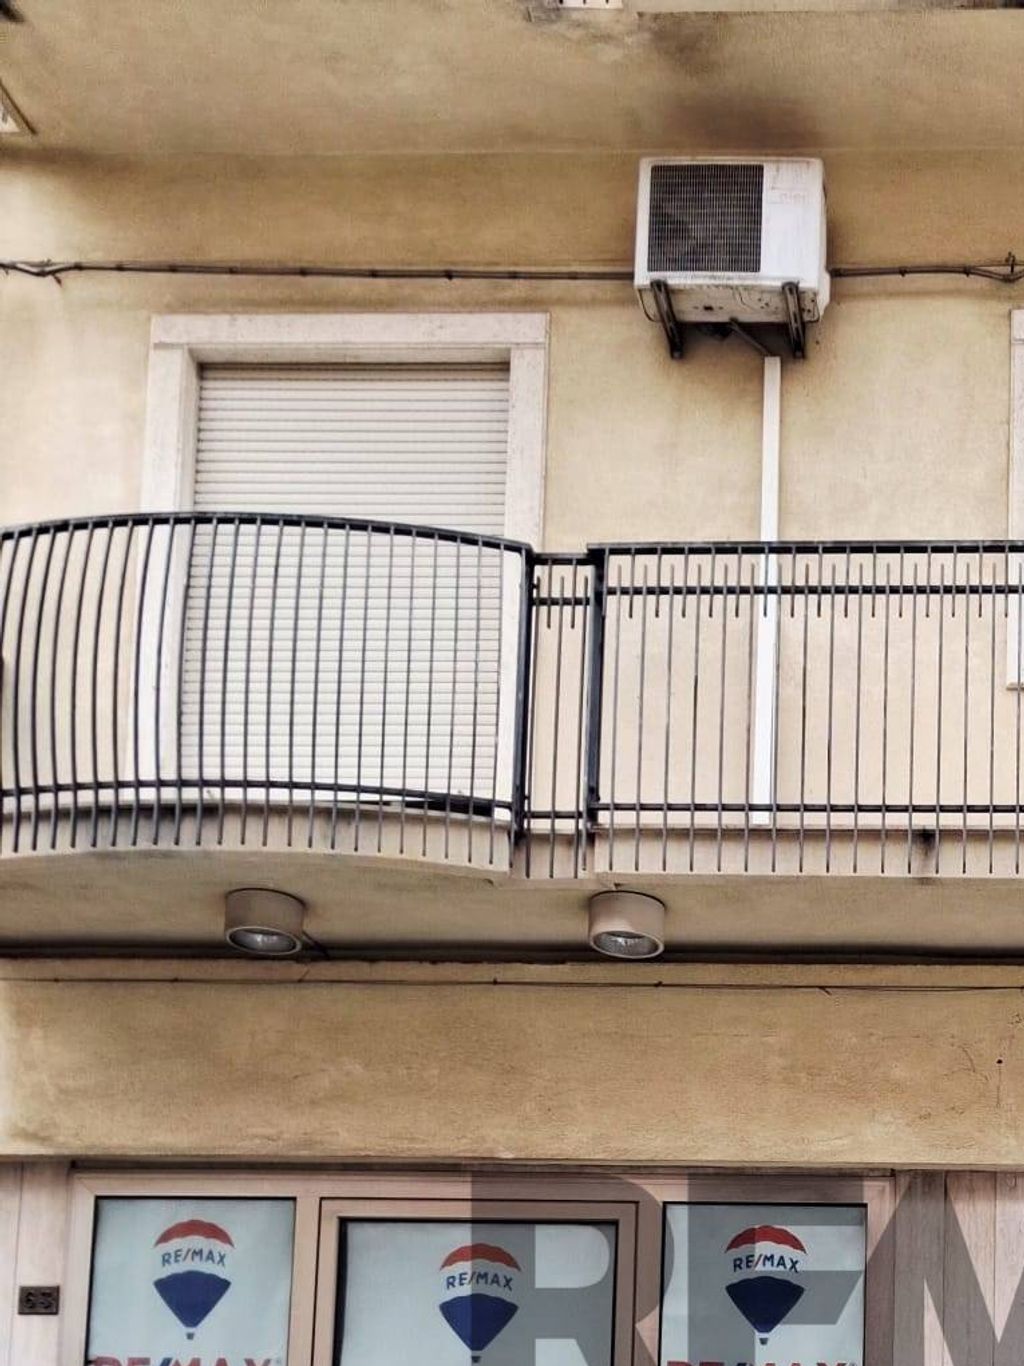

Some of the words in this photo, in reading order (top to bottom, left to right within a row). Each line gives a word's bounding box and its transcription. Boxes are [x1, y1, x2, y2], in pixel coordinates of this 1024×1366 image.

[161, 1248, 226, 1267] RE/MAX
[733, 1253, 799, 1273] RE/MAX
[446, 1272, 513, 1292] RE/MAX
